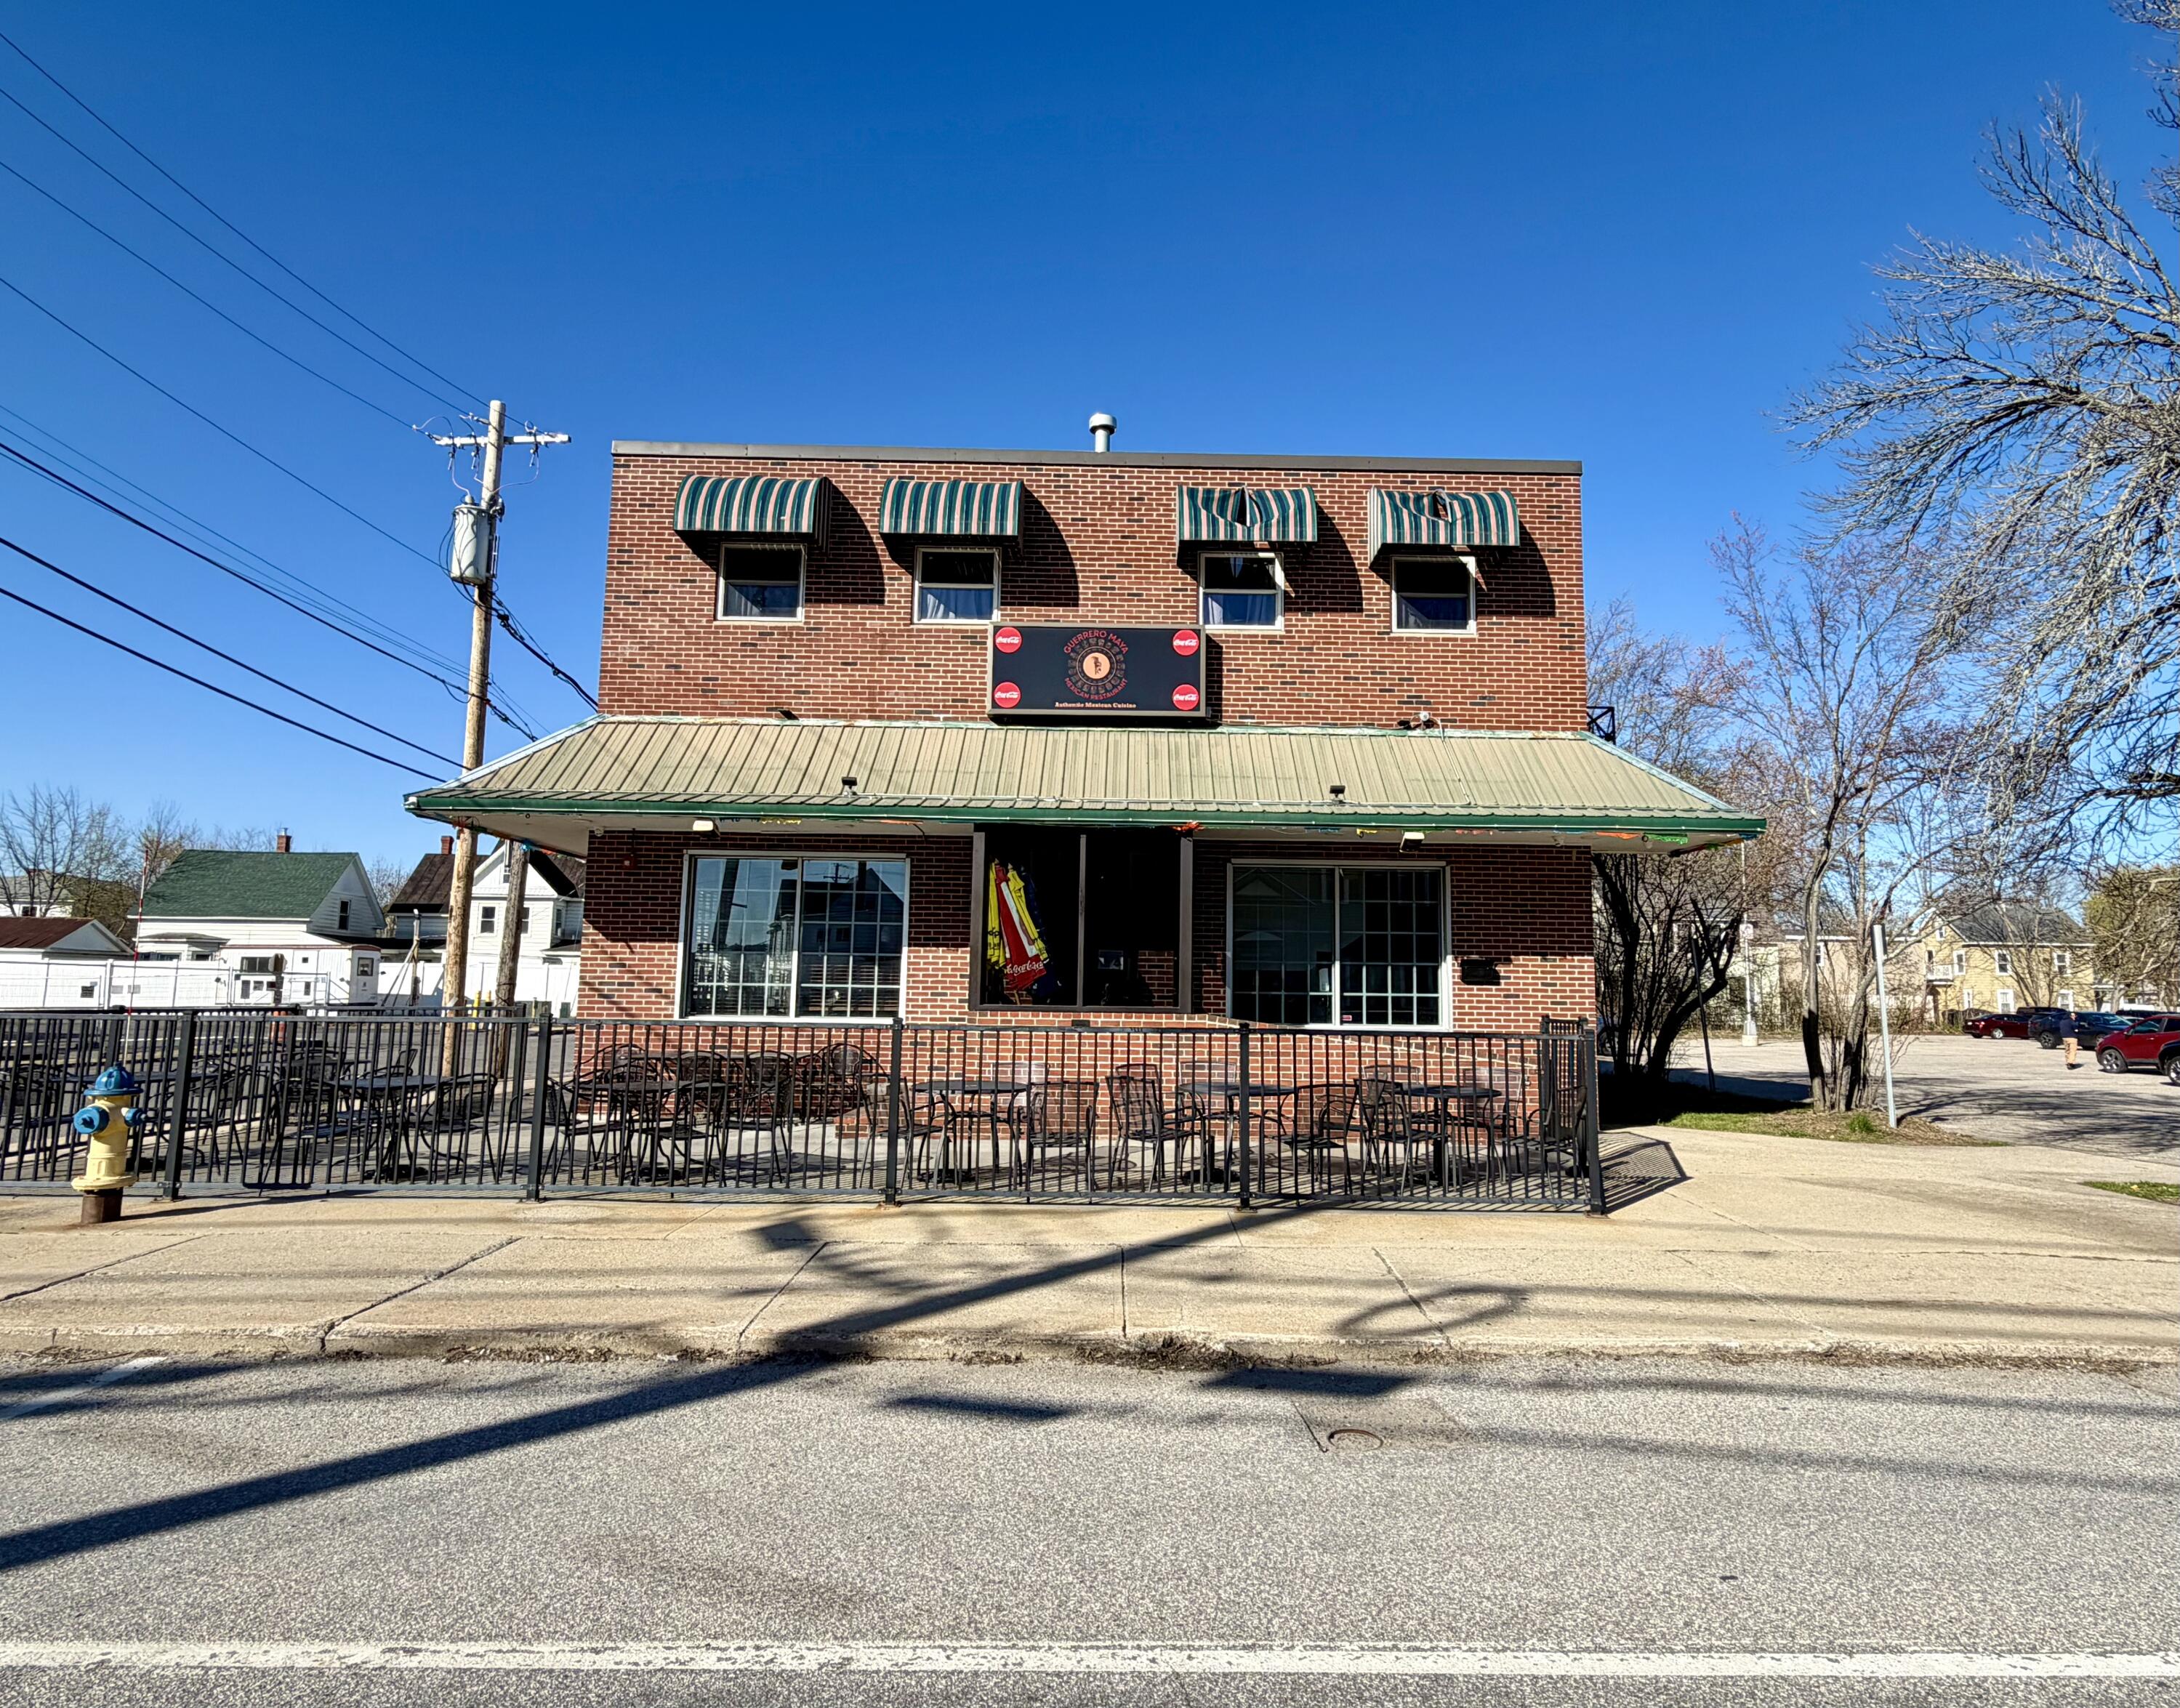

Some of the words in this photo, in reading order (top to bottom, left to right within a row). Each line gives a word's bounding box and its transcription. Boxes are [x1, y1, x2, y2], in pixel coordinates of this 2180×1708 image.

[1063, 630, 1107, 653] GUERRERO
[1108, 633, 1128, 654] MAYA
[1064, 677, 1090, 698] MEXICAN
[1090, 678, 1127, 700] RESTAURANT
